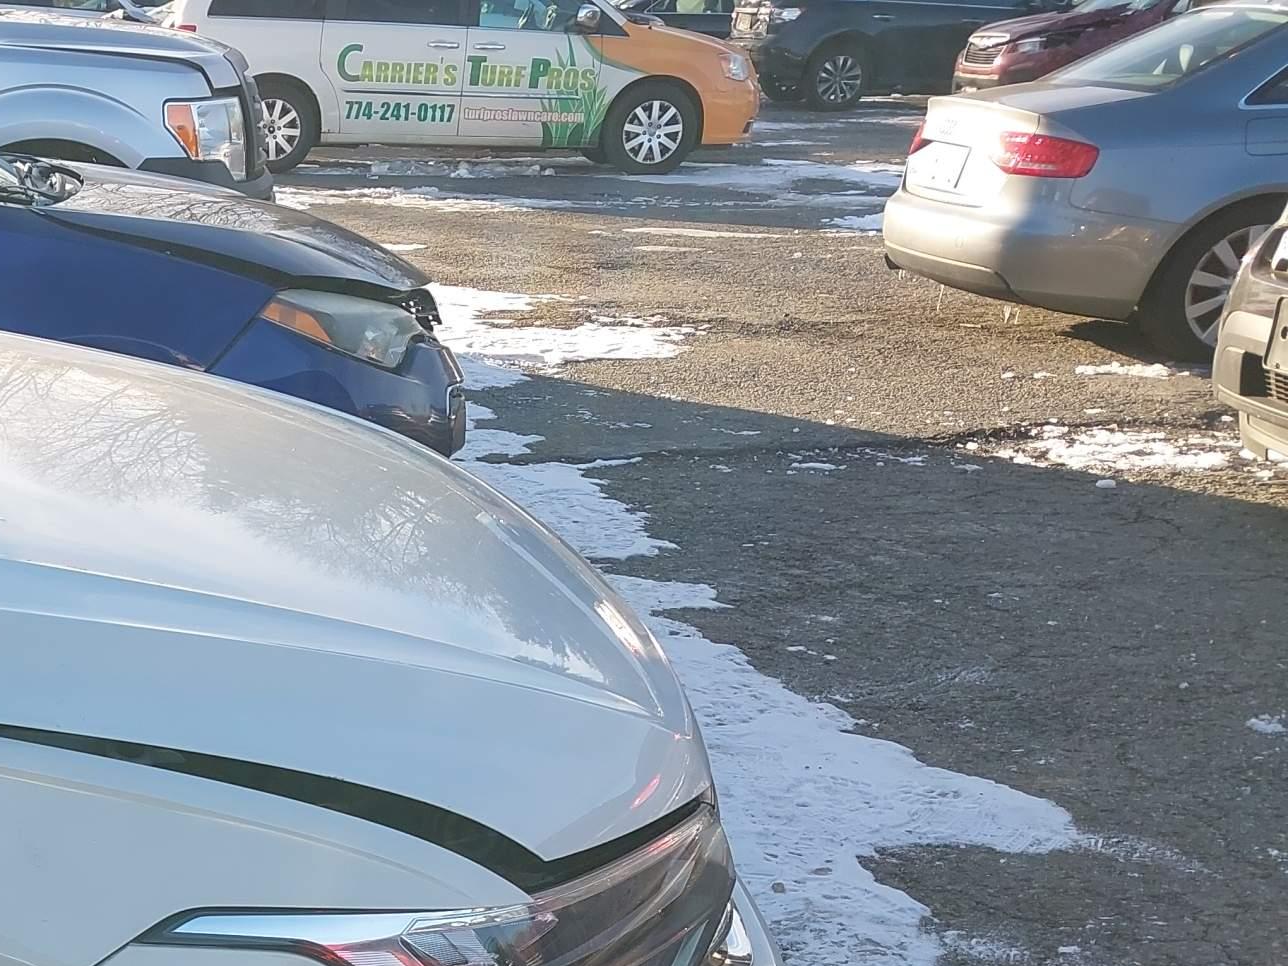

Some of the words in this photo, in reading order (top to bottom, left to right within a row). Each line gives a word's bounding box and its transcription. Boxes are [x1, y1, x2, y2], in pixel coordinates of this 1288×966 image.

[337, 43, 458, 86] CARRIER'S
[467, 55, 527, 88] TURF
[528, 58, 596, 91] PROS
[345, 100, 456, 123] 774-241-0117
[464, 107, 585, 122] turfproslawncare.com
